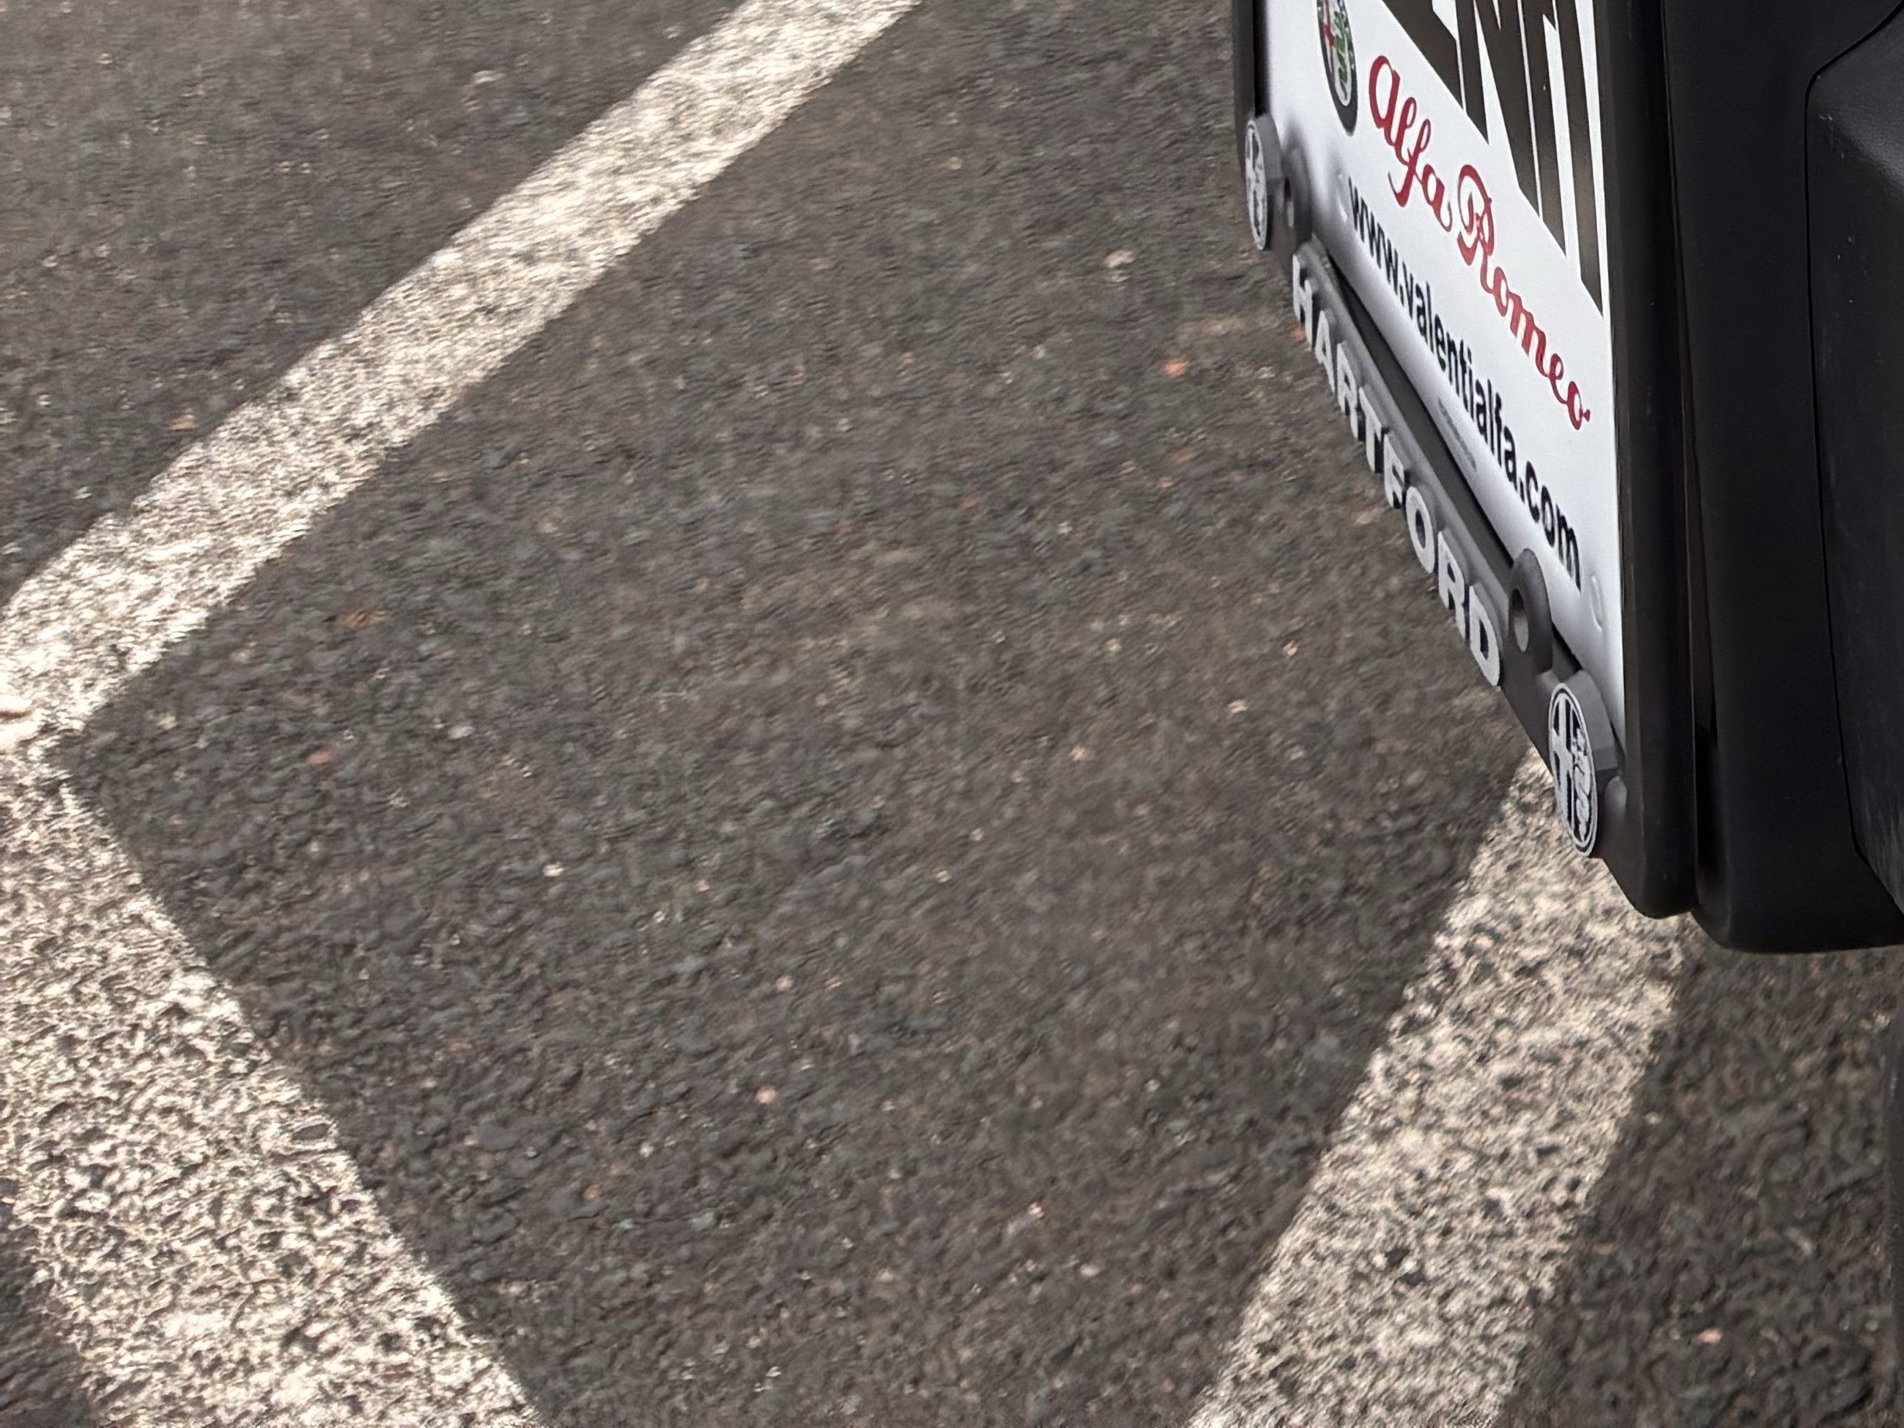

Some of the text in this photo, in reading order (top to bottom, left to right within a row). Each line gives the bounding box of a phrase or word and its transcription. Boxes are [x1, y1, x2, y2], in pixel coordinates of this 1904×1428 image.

[1347, 174, 1582, 592] www.valentialfa.com
[1368, 54, 1592, 432] Alfa Romeo
[1291, 254, 1502, 687] HARTFORD
